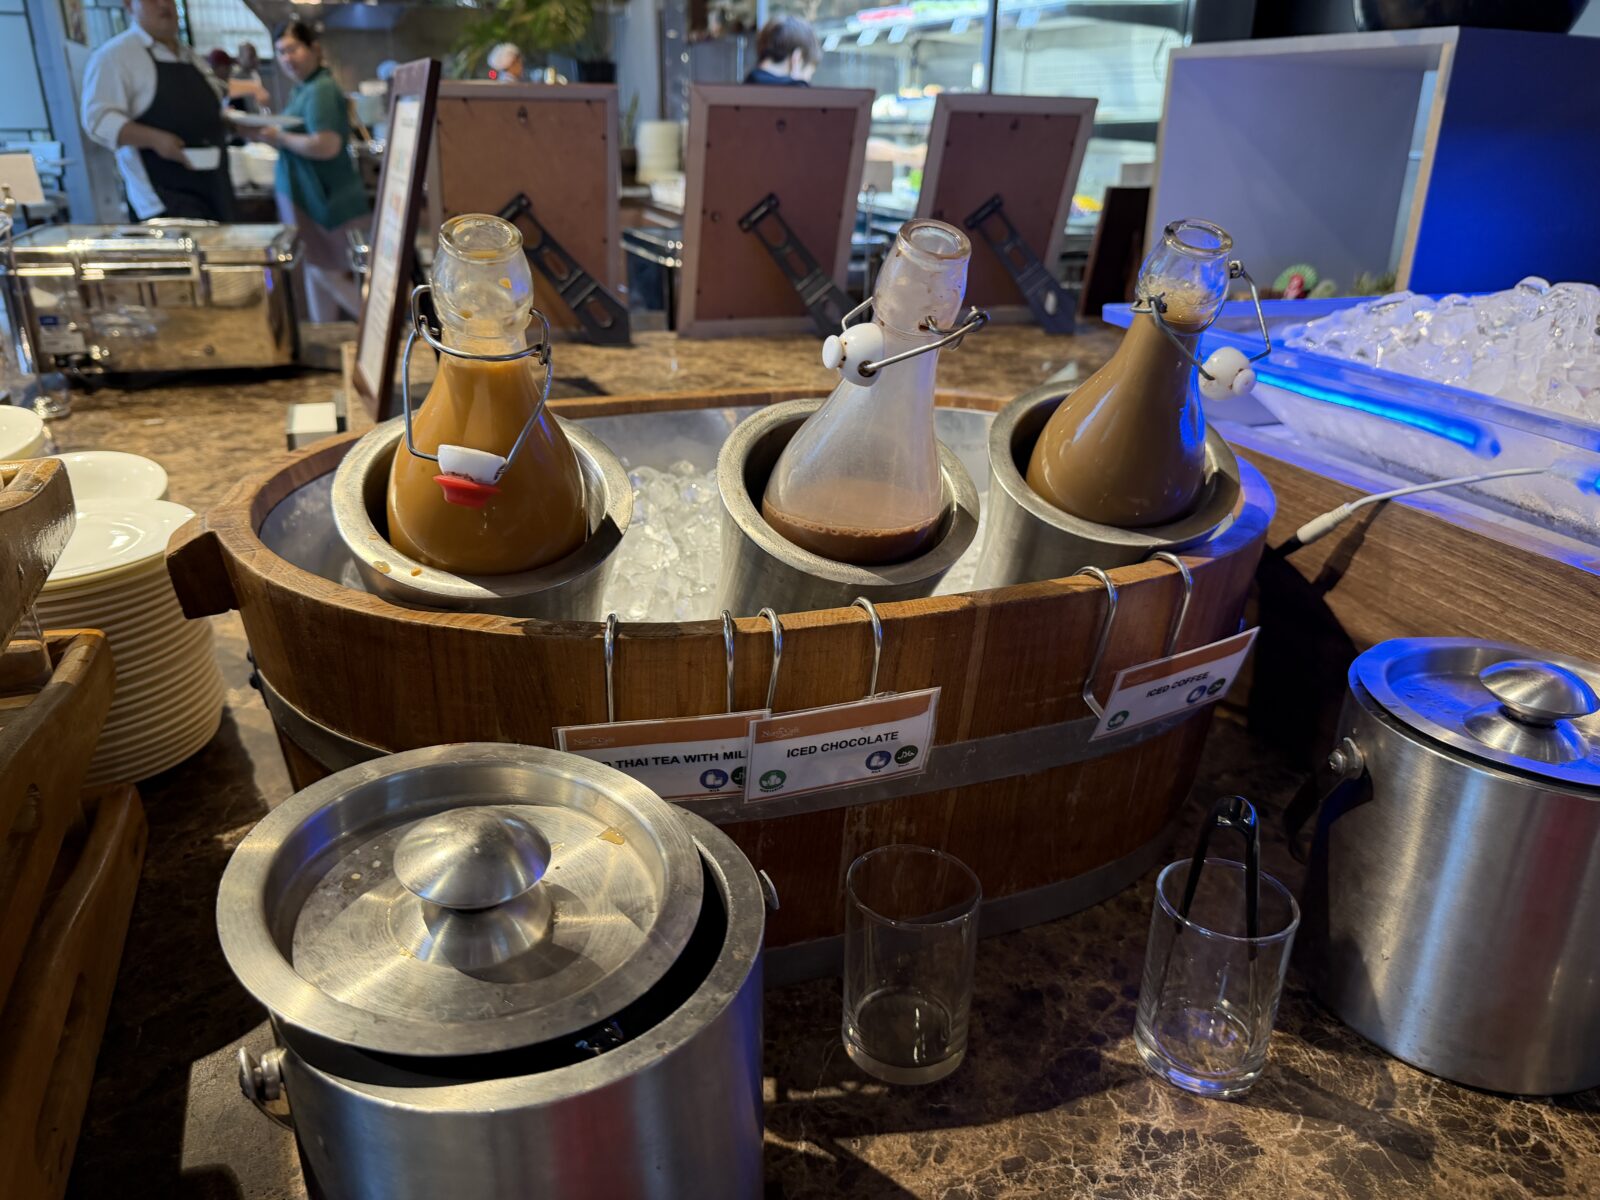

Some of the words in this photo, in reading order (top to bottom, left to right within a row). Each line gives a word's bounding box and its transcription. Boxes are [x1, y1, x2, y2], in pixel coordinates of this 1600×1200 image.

[1146, 685, 1170, 698] ICED
[1171, 671, 1210, 690] COFFEE
[786, 745, 817, 758] ICED
[821, 731, 899, 753] CHOCOLATE
[615, 758, 649, 769] THAI
[652, 756, 680, 766] TEA
[684, 753, 719, 763] WITH
[723, 750, 747, 760] MIL
